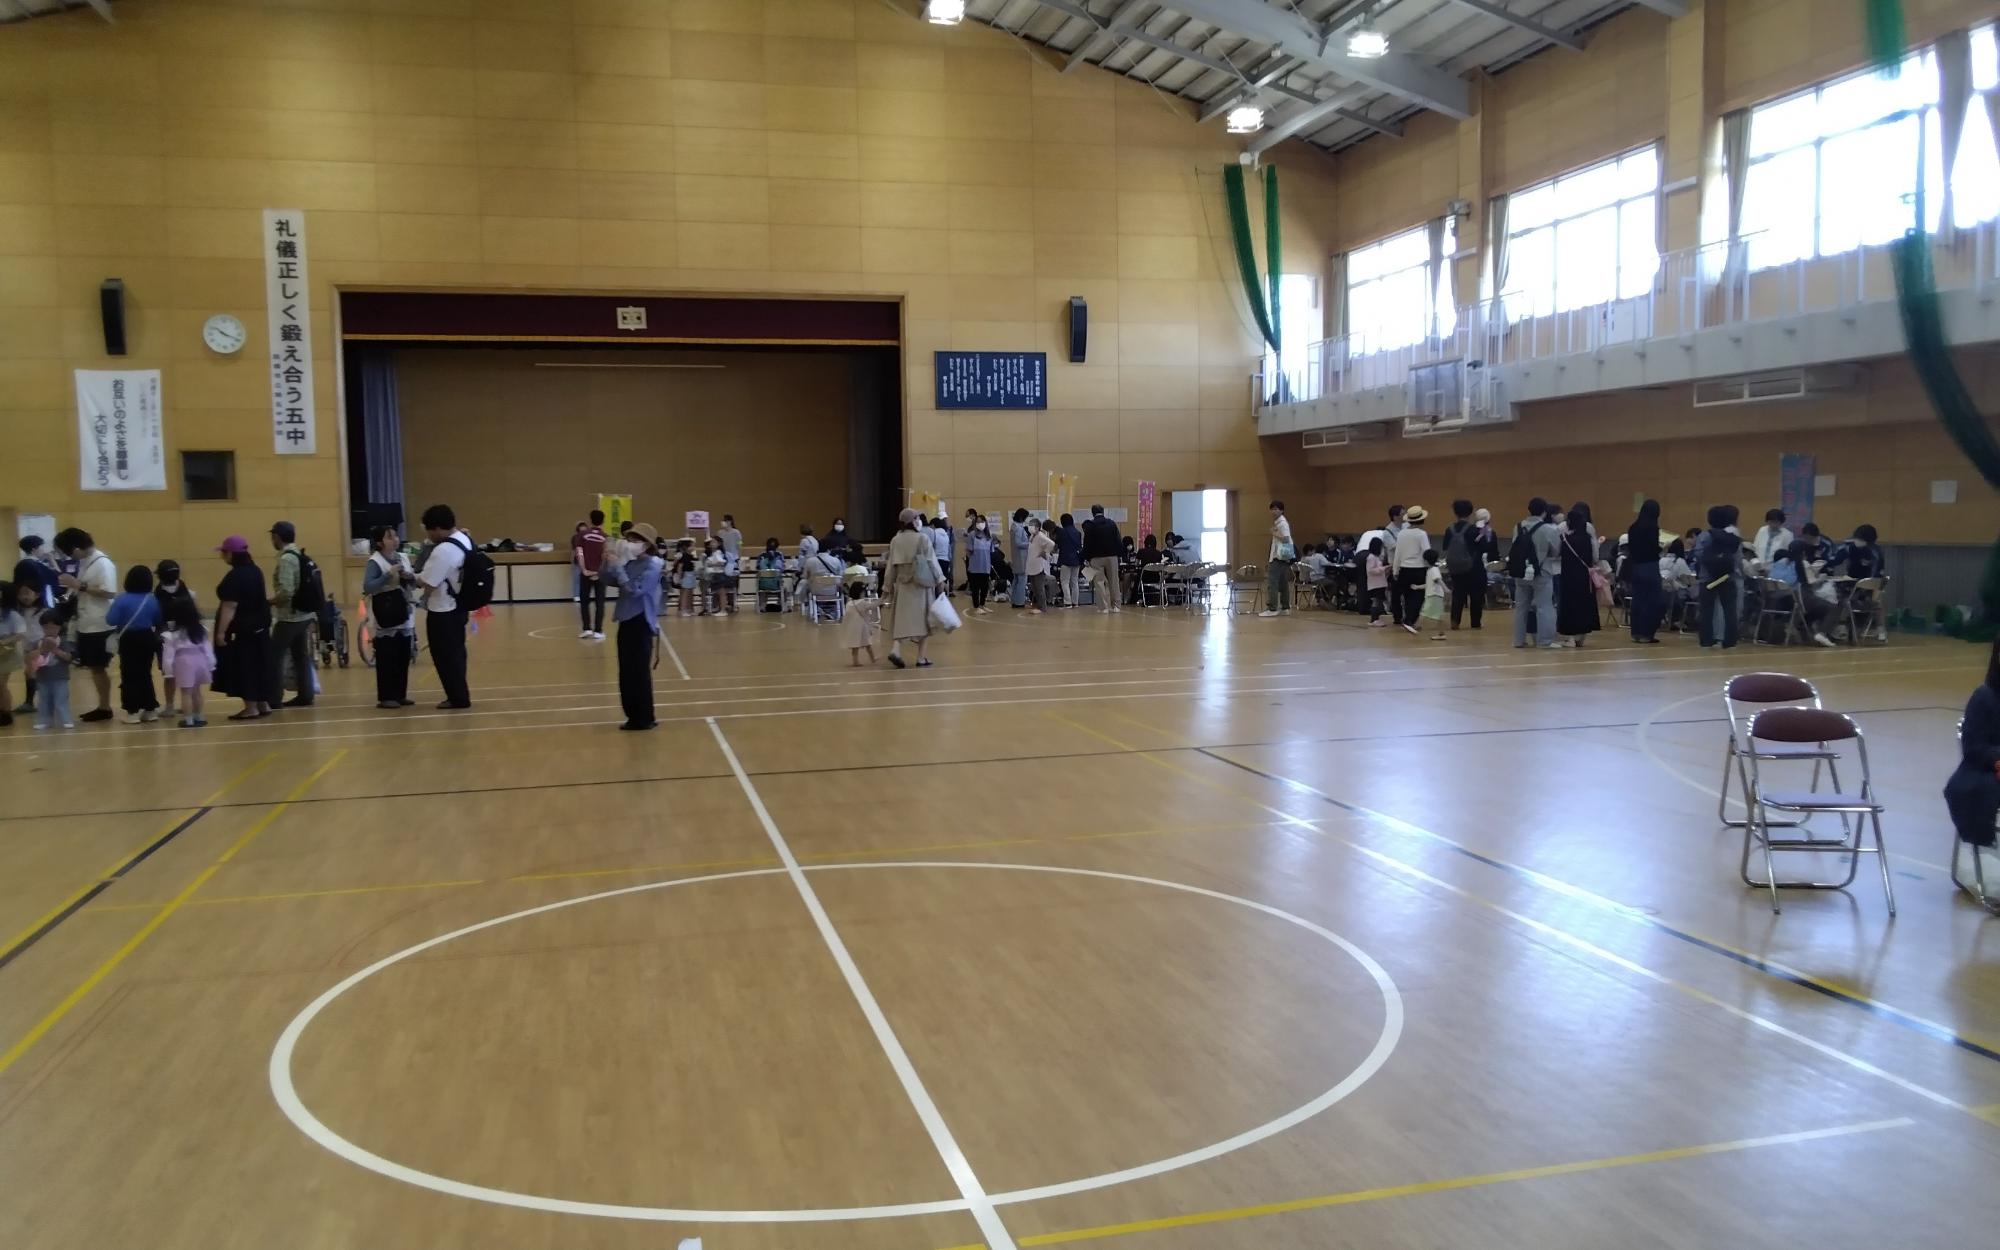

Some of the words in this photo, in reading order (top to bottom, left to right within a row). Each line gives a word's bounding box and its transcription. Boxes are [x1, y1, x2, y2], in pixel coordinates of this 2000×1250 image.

[275, 219, 306, 446] 礼儀正しく鍛え合う五中
